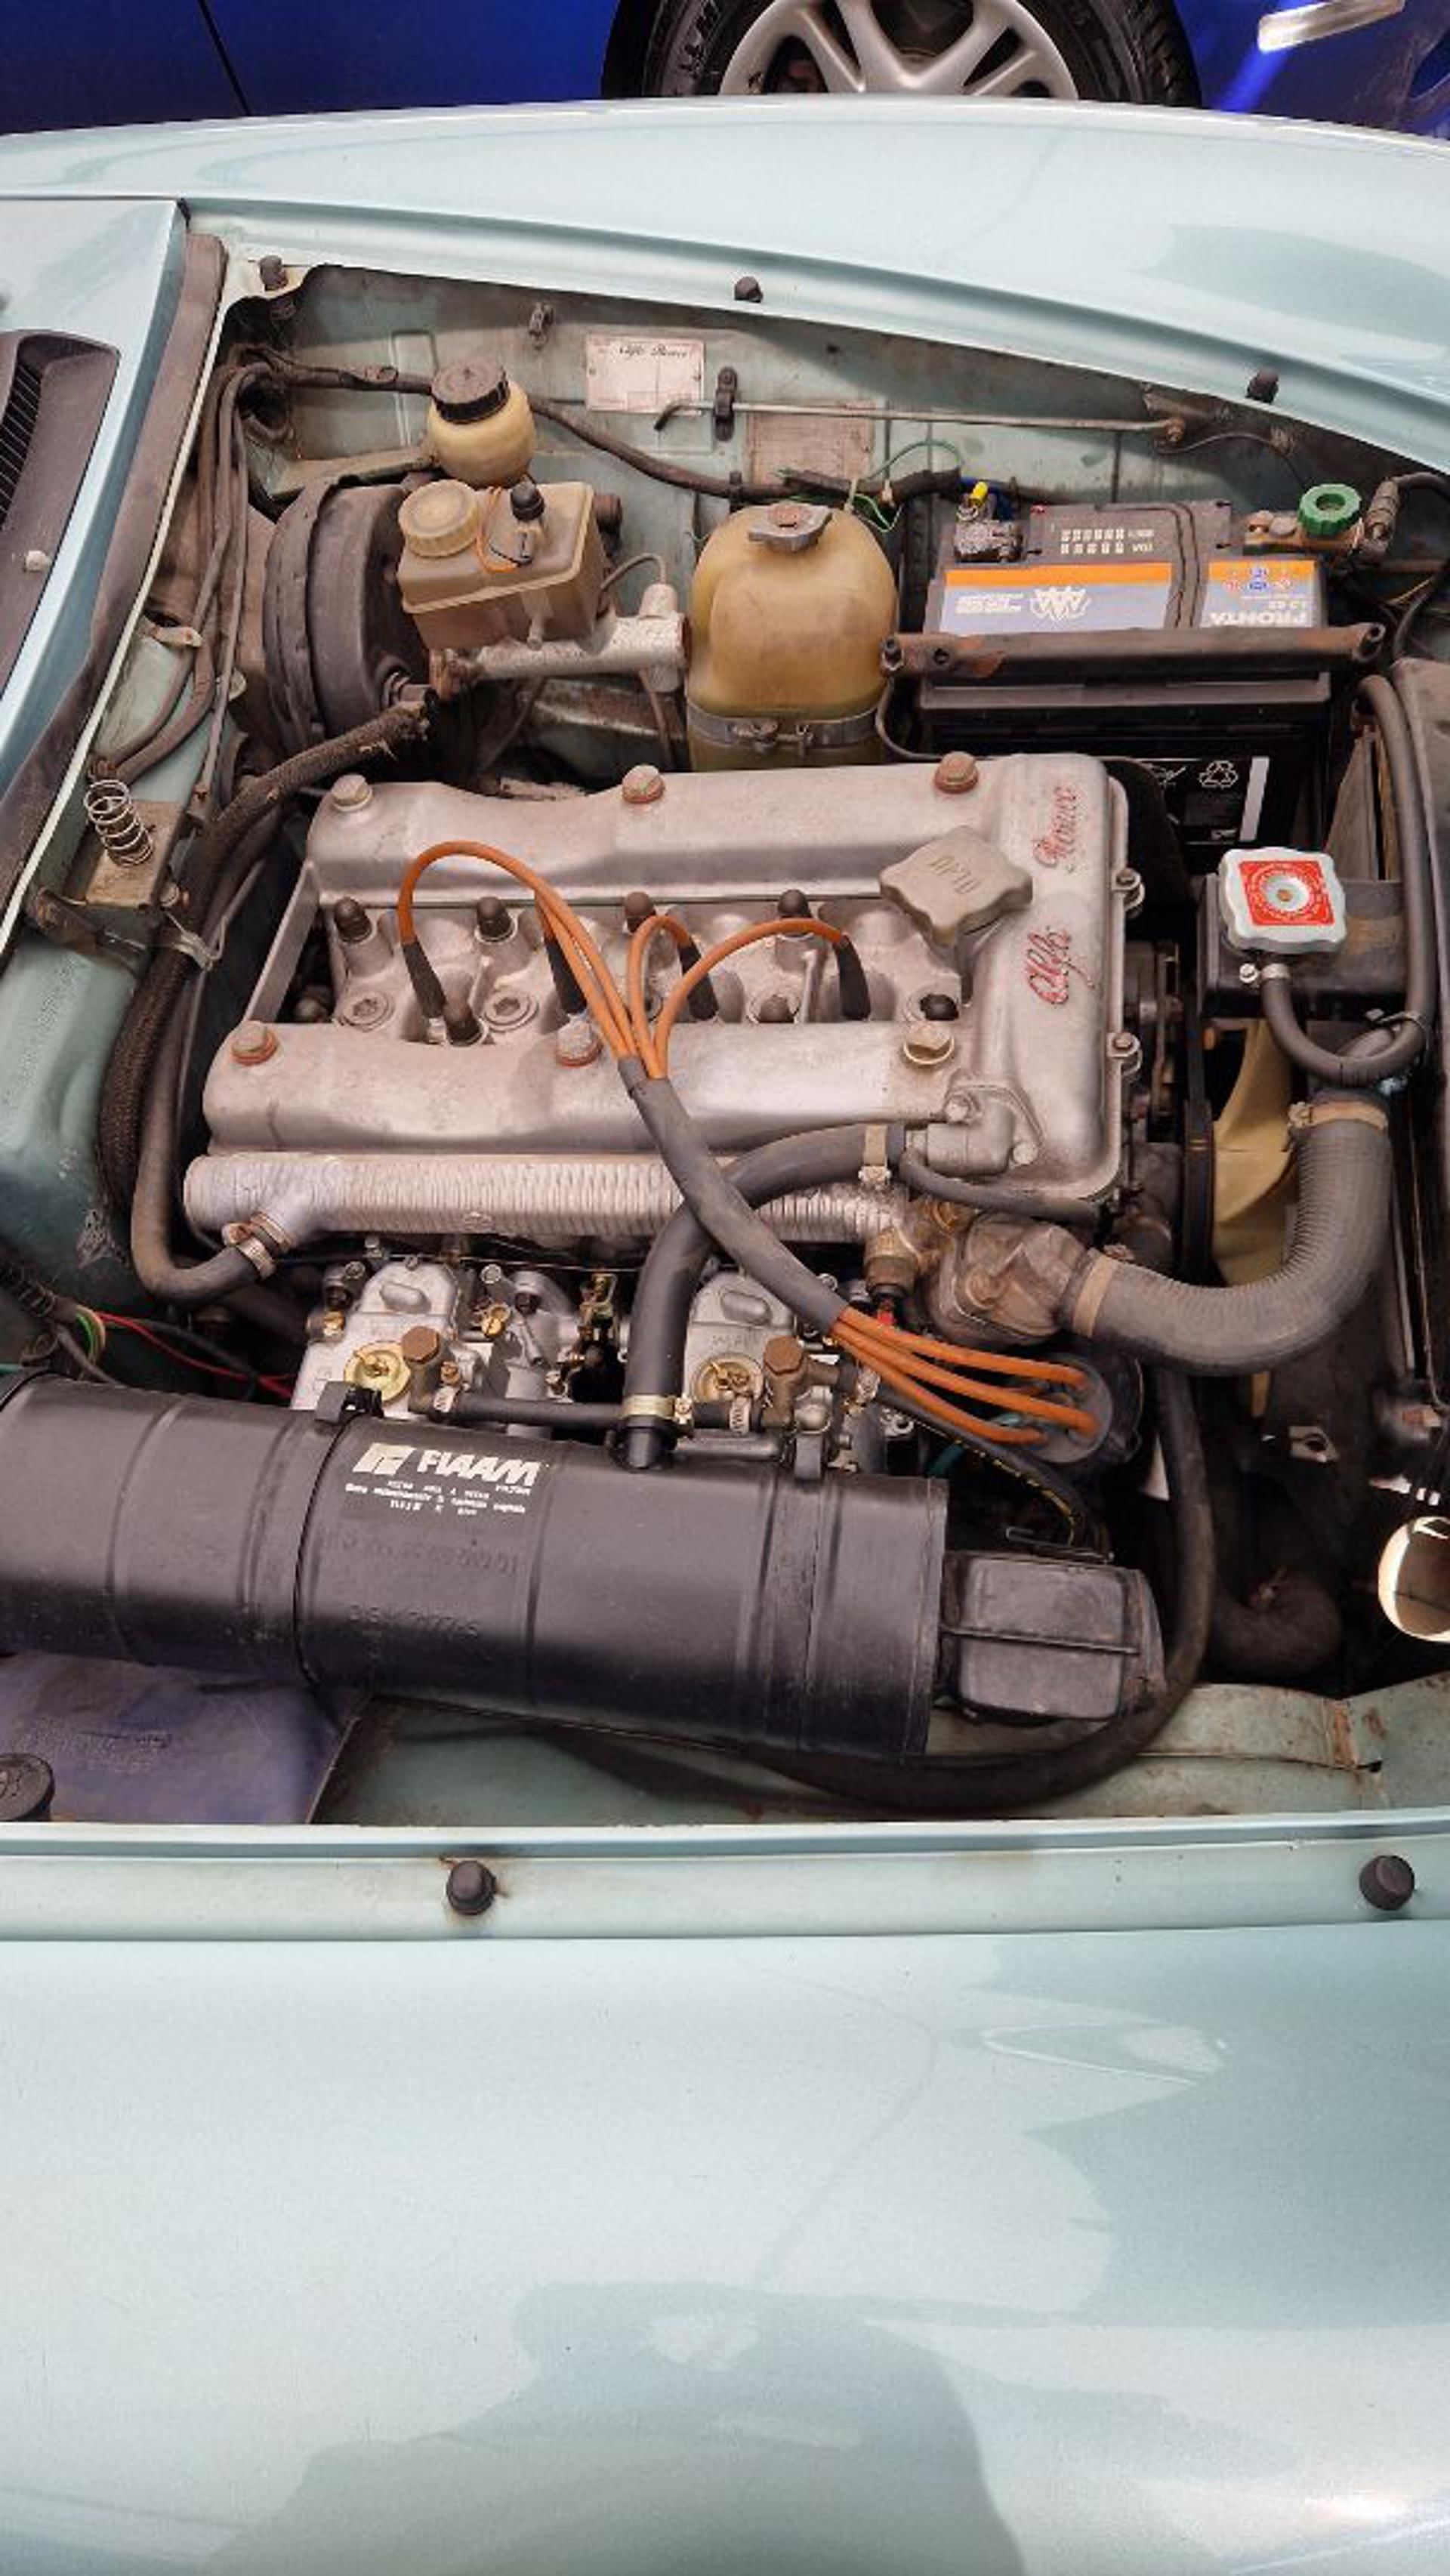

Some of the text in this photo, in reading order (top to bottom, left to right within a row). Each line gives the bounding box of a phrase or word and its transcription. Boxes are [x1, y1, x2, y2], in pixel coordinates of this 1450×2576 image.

[1210, 612, 1307, 628] PRONTA
[1026, 927, 1096, 1006] Alfa
[417, 1448, 541, 1486] FIAAM
